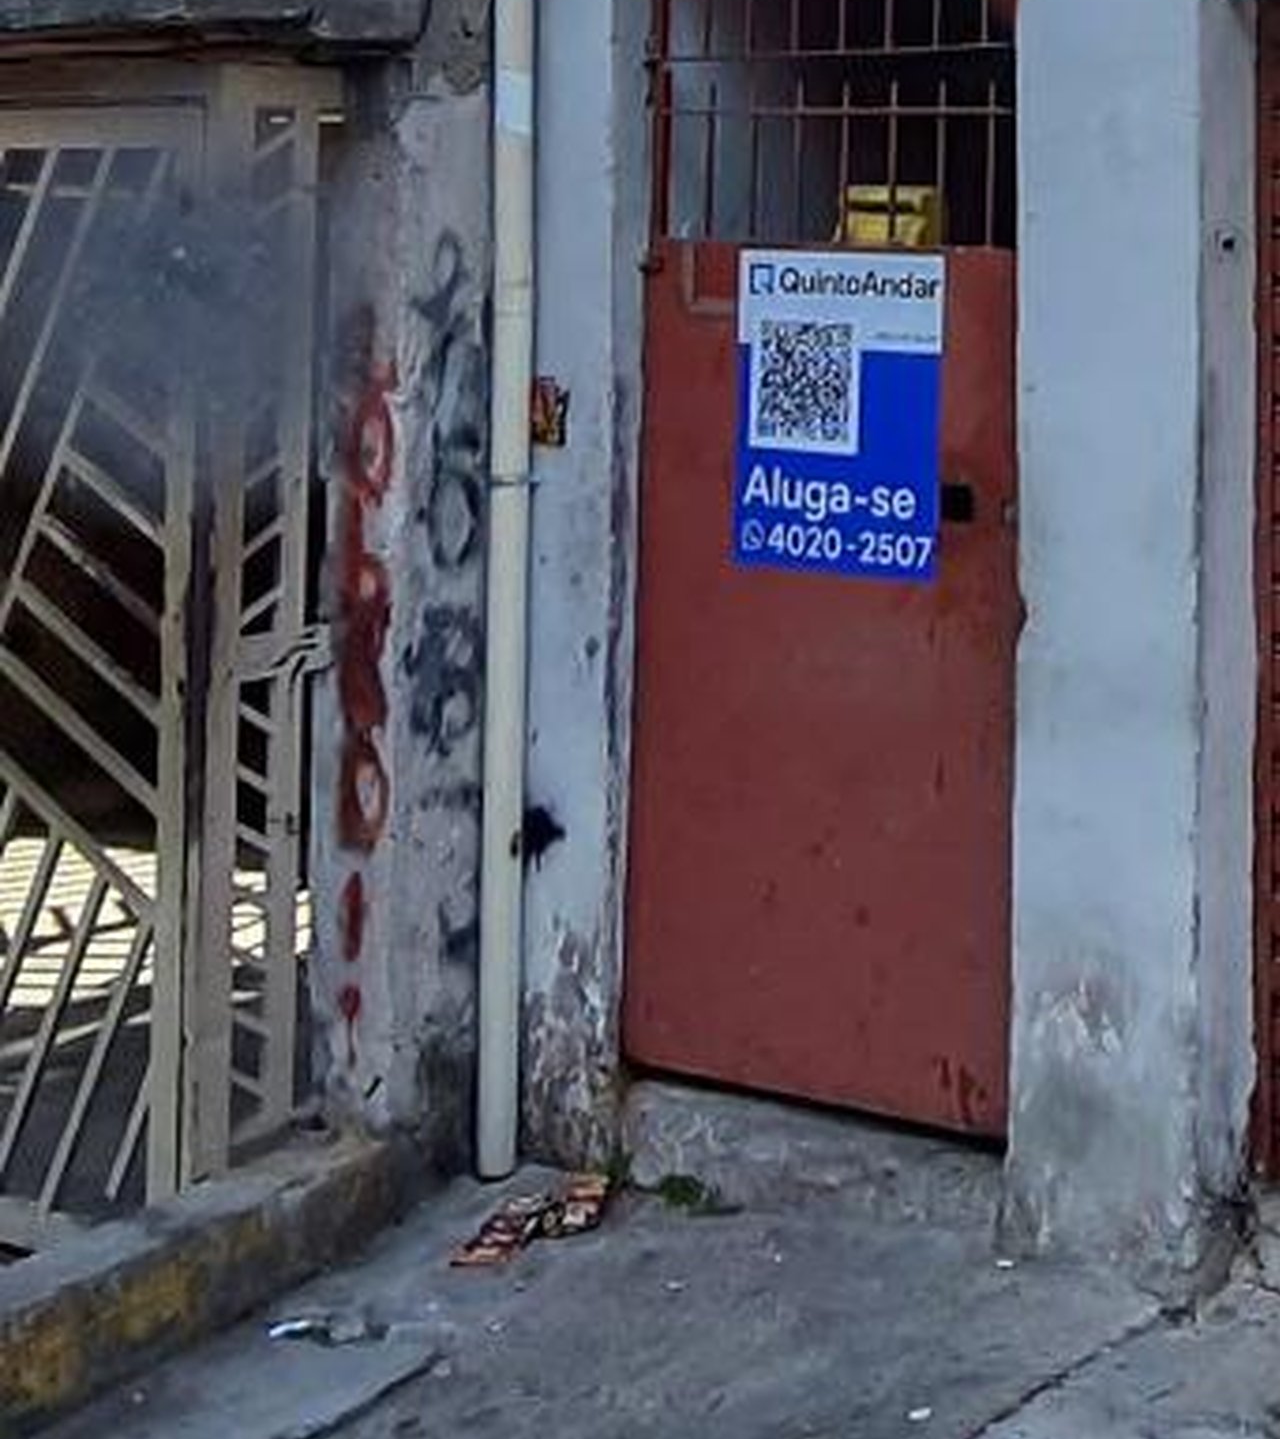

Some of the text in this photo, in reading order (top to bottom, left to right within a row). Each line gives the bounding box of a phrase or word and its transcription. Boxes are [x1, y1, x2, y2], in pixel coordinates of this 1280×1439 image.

[779, 267, 940, 299] QuintoAndar
[742, 465, 916, 521] Aluga-se
[767, 523, 932, 568] 4020-2507
